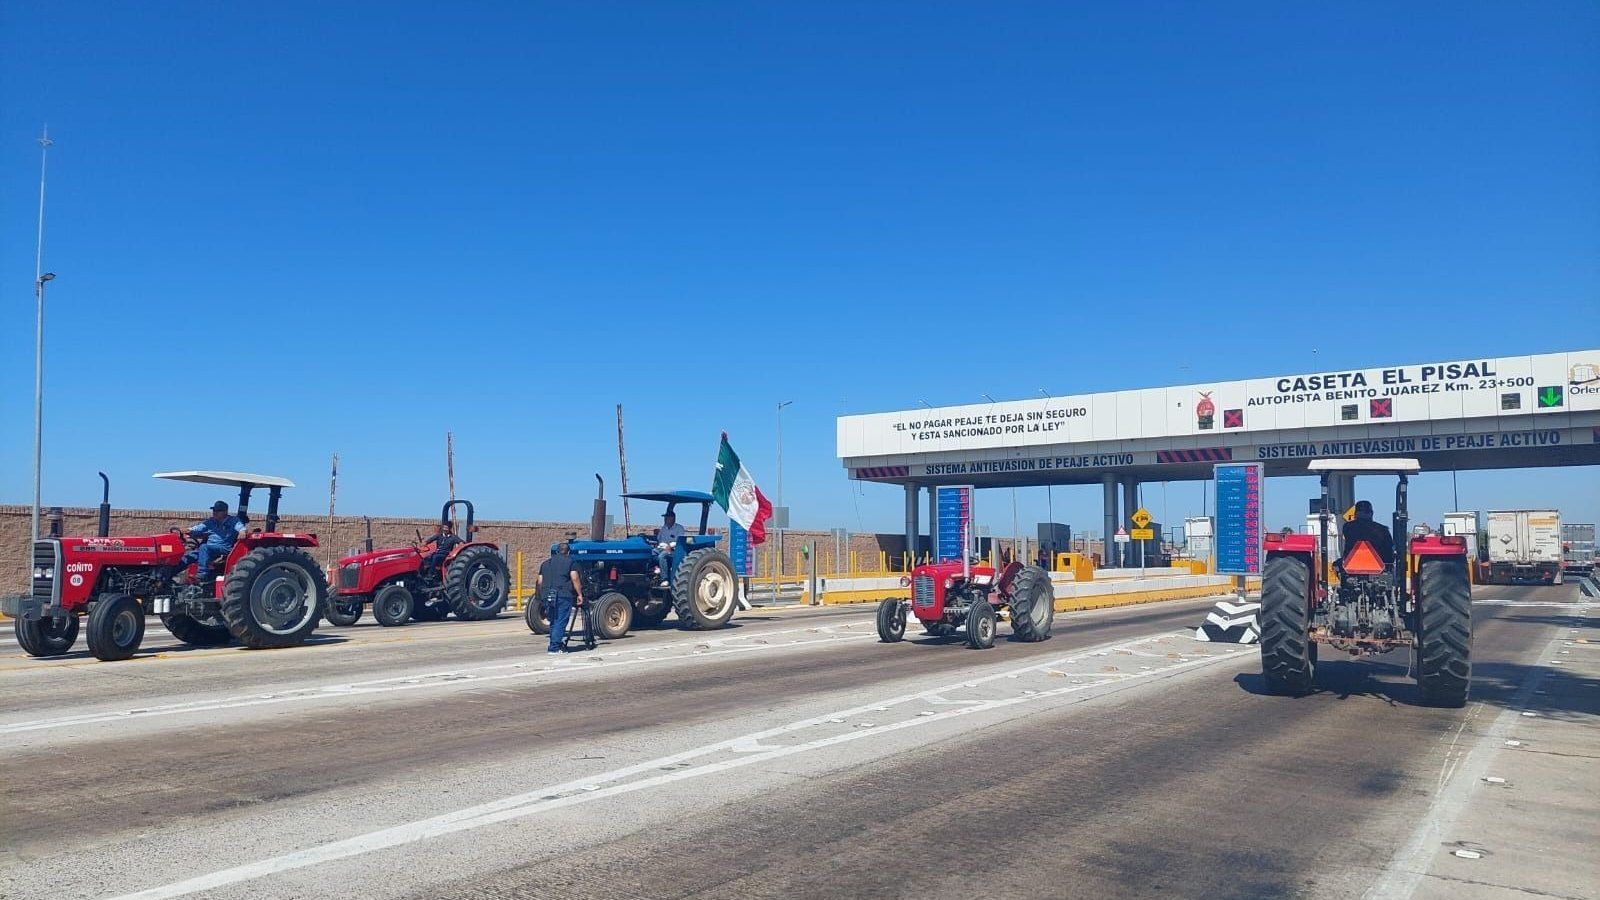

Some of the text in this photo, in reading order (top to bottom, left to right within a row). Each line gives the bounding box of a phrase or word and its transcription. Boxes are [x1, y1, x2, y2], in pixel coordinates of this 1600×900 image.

[1277, 361, 1496, 393] CASETA EL PISAL
[1248, 376, 1534, 406] AUTOPISTA BENITO JUAREZ Km. 23+500
[910, 421, 922, 430] NO
[924, 419, 952, 428] PAGAR
[955, 416, 983, 426] PEAJE
[986, 415, 997, 424] TE
[1000, 413, 1024, 423] DEJA
[1027, 411, 1043, 420] SIN
[1046, 407, 1087, 419] SEGURO
[912, 432, 917, 441] Y
[920, 431, 941, 440] ESTA
[944, 426, 1002, 439] SANCIONADO
[1006, 424, 1024, 434] POR
[1028, 423, 1039, 433] LA
[1259, 430, 1561, 459] SISTEMA ANTIEVASION DE PEAJE ACTIVO
[926, 454, 1134, 475] SISTEMA ANTIEVASION DE PEAJE ACTIVO
[67, 562, 93, 572] COÑITO
